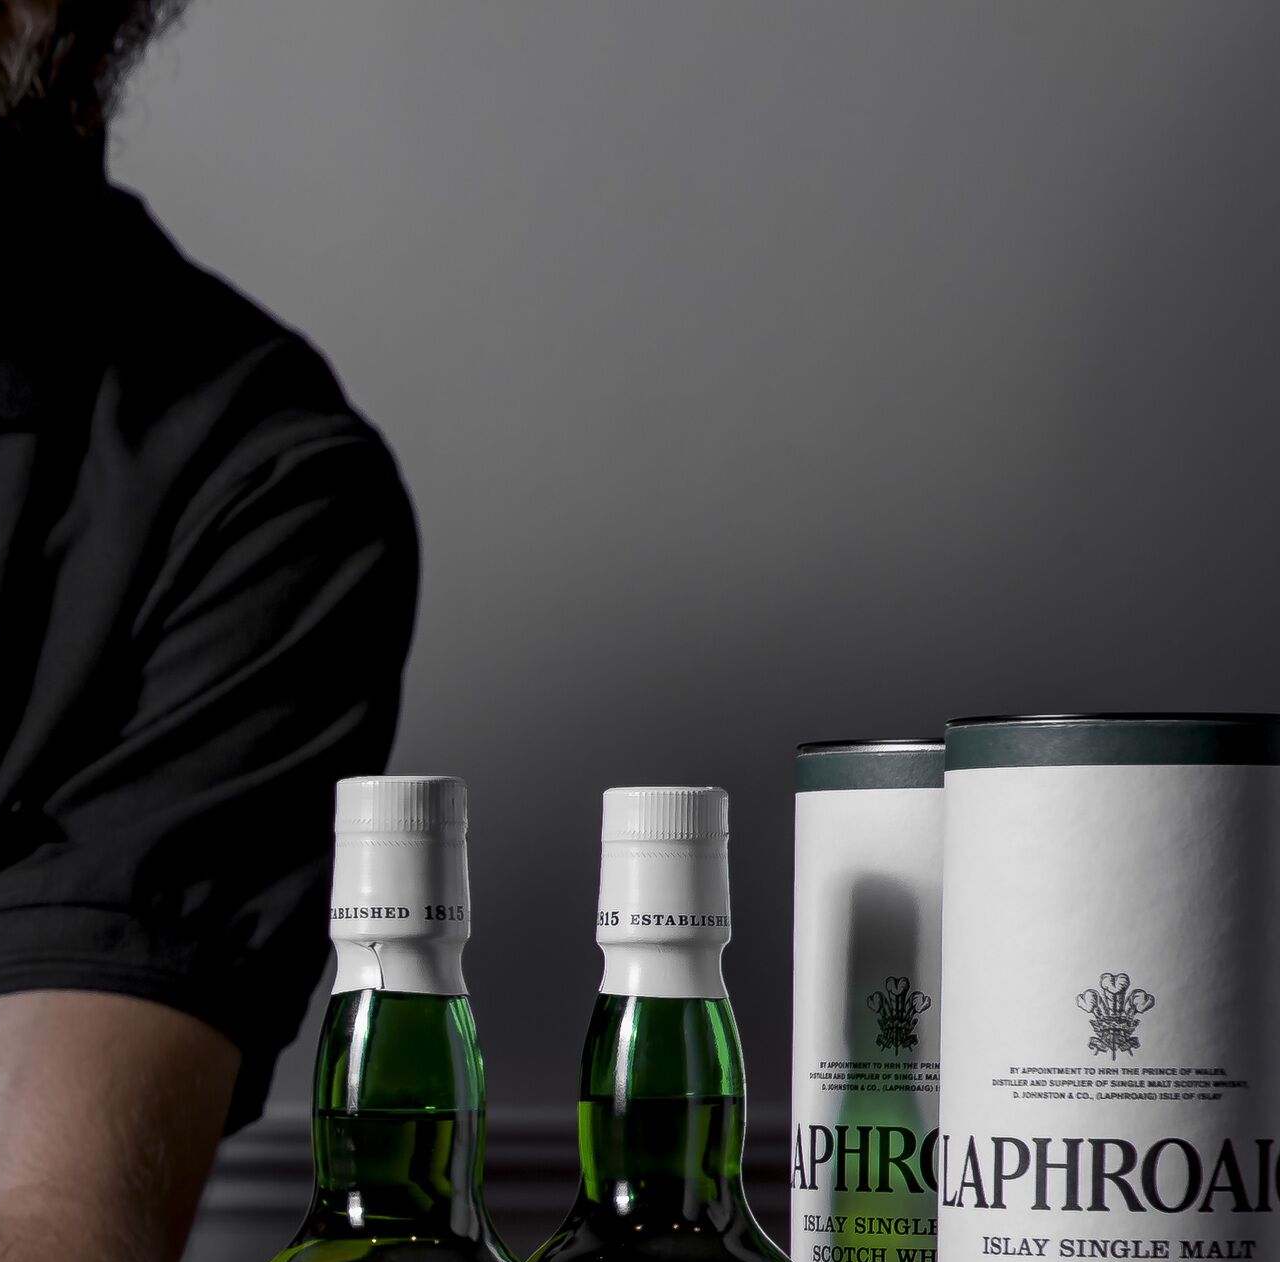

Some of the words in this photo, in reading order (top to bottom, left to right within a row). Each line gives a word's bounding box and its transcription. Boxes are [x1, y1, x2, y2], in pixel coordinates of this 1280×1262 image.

[424, 905, 464, 920] 1815
[598, 911, 620, 926] 815
[942, 1134, 1280, 1214] LAPHROAI
[804, 1214, 848, 1233] ISLAY
[982, 1236, 1046, 1256] ISLAY
[1059, 1238, 1169, 1260] SINGLE
[1180, 1240, 1256, 1260] MALT
